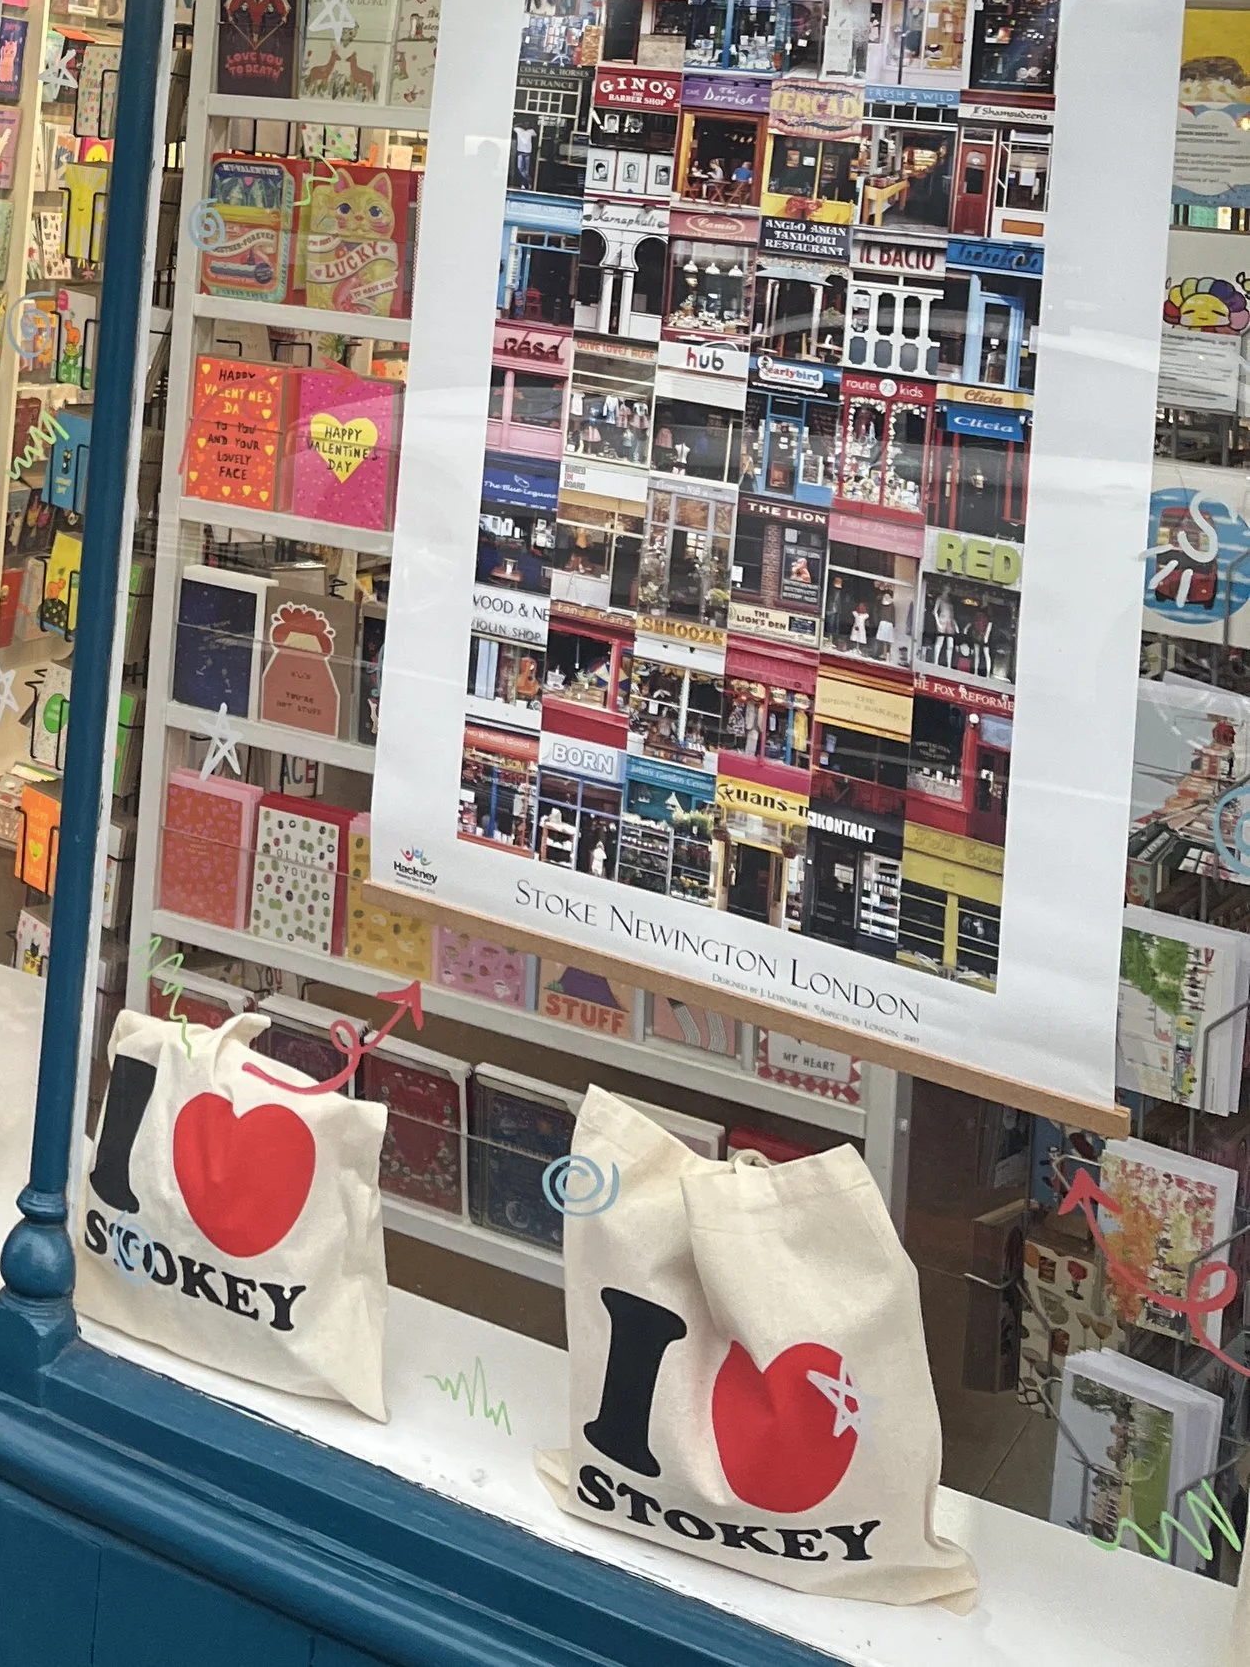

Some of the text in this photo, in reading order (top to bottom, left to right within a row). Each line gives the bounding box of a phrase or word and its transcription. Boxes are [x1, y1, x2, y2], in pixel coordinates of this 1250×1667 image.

[227, 50, 284, 65] LOVE YOU
[229, 64, 282, 78] TO DEATH
[520, 77, 574, 90] ENTRANCE
[600, 77, 677, 101] GINO'S
[609, 93, 666, 107] BARBER SHOP
[869, 88, 905, 100] FRESH
[922, 93, 954, 103] WILD
[765, 219, 806, 233] ANGLO
[810, 224, 847, 236] ASIAN
[774, 230, 836, 246] TANDOORI
[764, 239, 844, 257] RESTAURANT
[325, 241, 379, 279] LUCKY
[859, 246, 876, 265] IL
[879, 247, 936, 271] BACIO
[687, 346, 724, 371] hub
[767, 366, 820, 383] earlybird
[845, 379, 877, 391] route
[900, 384, 924, 398] kids
[963, 389, 1003, 405] Clicia
[324, 425, 362, 442] HAPPY
[953, 416, 1015, 434] Clicia
[208, 432, 260, 451] AND YOUR
[307, 440, 378, 461] VALENTINE'S
[217, 449, 252, 467] LOVELY
[326, 459, 351, 473] DAY
[218, 465, 248, 481] FACE
[748, 502, 1020, 584] THE LION RED
[518, 604, 529, 618] &
[754, 610, 770, 619] THE
[737, 614, 787, 631] LION'S DEN
[933, 683, 955, 697] FOX
[296, 704, 322, 717] STUFF
[552, 742, 614, 774] BORN
[276, 848, 316, 866] OLIVE
[283, 864, 308, 879] YOU
[393, 860, 438, 884] Hackney
[515, 879, 920, 1024] STOKE NEWINGTON LONDON
[545, 994, 626, 1034] STUFF
[783, 1051, 835, 1073] MY HEART
[583, 1286, 688, 1478] I
[577, 1464, 881, 1562] STOKEY
